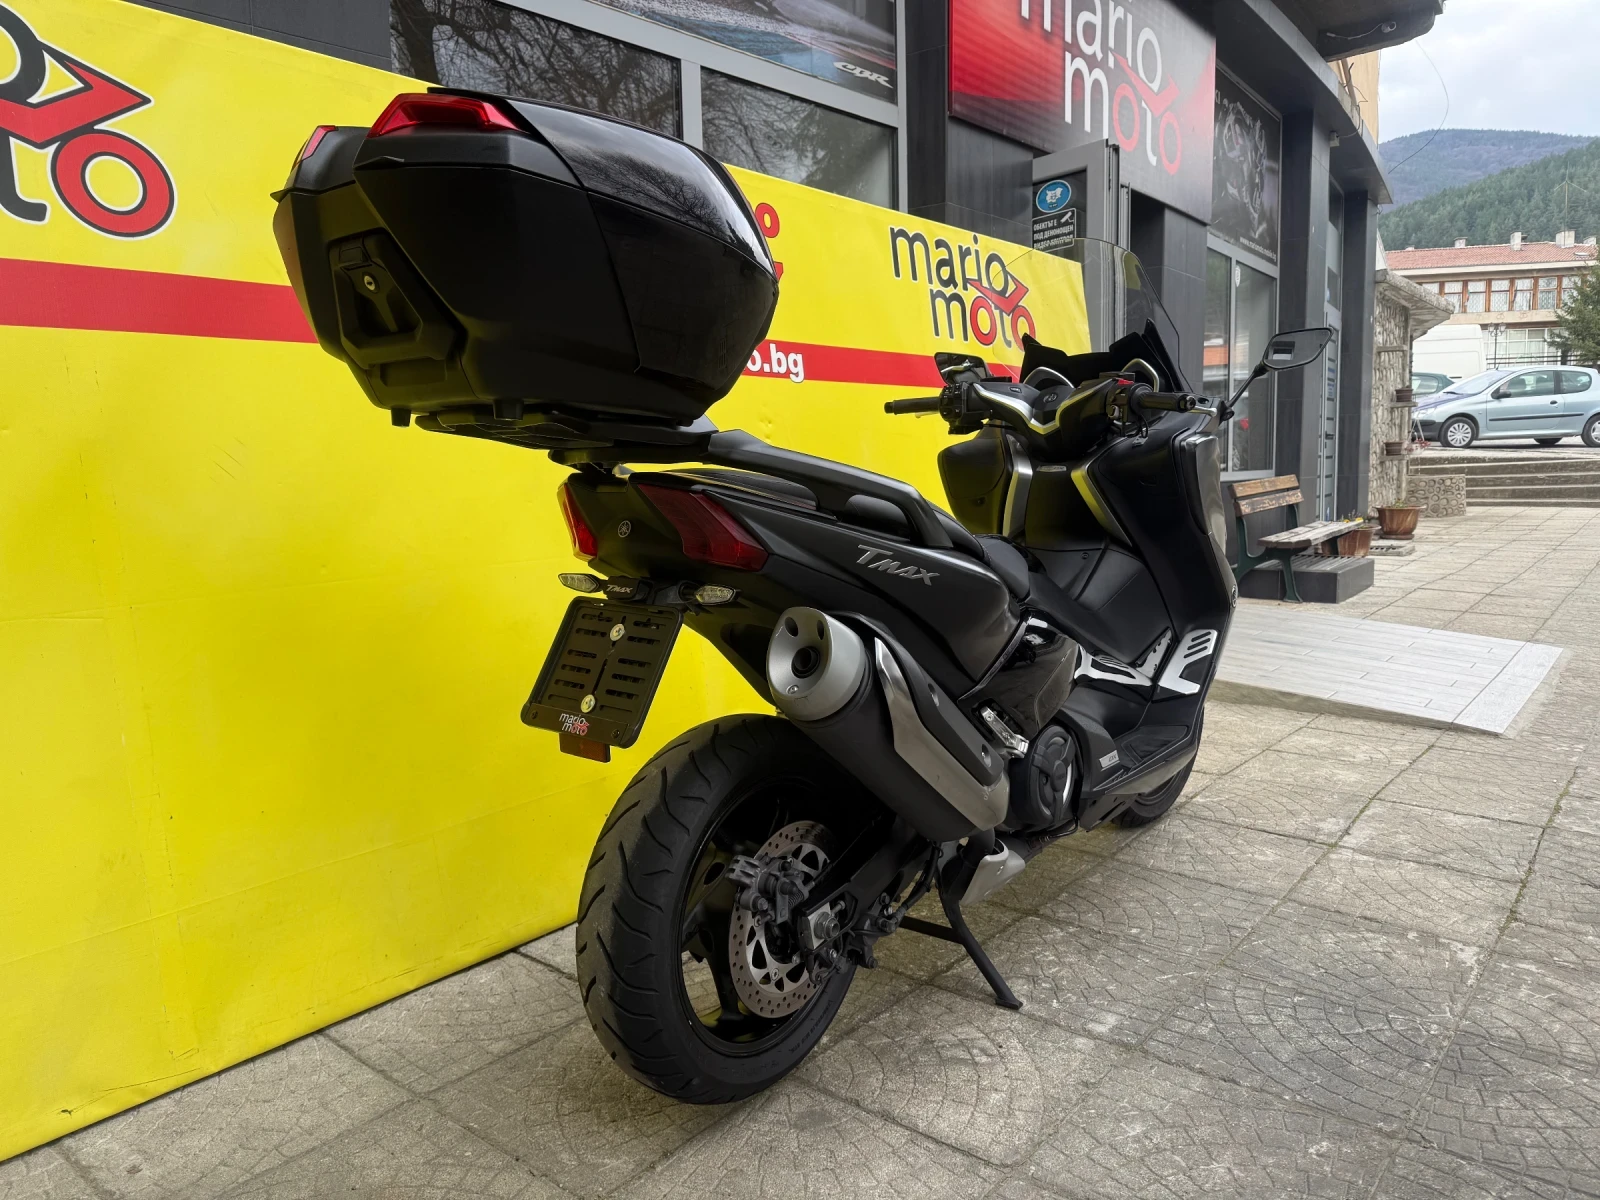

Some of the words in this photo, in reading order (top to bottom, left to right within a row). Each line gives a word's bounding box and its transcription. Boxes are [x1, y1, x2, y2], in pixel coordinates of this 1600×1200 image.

[833, 61, 894, 89] CBR
[1064, 51, 1182, 175] moto
[1033, 219, 1054, 231] ОБЕКТЪТ
[1033, 231, 1044, 241] ПОД
[1043, 224, 1074, 239] ДЕНОНОЩЕН
[890, 226, 1009, 297] mario
[930, 288, 1036, 352] moto
[745, 343, 804, 383] o.bg
[559, 713, 586, 725] mario
[561, 722, 587, 735] moto
